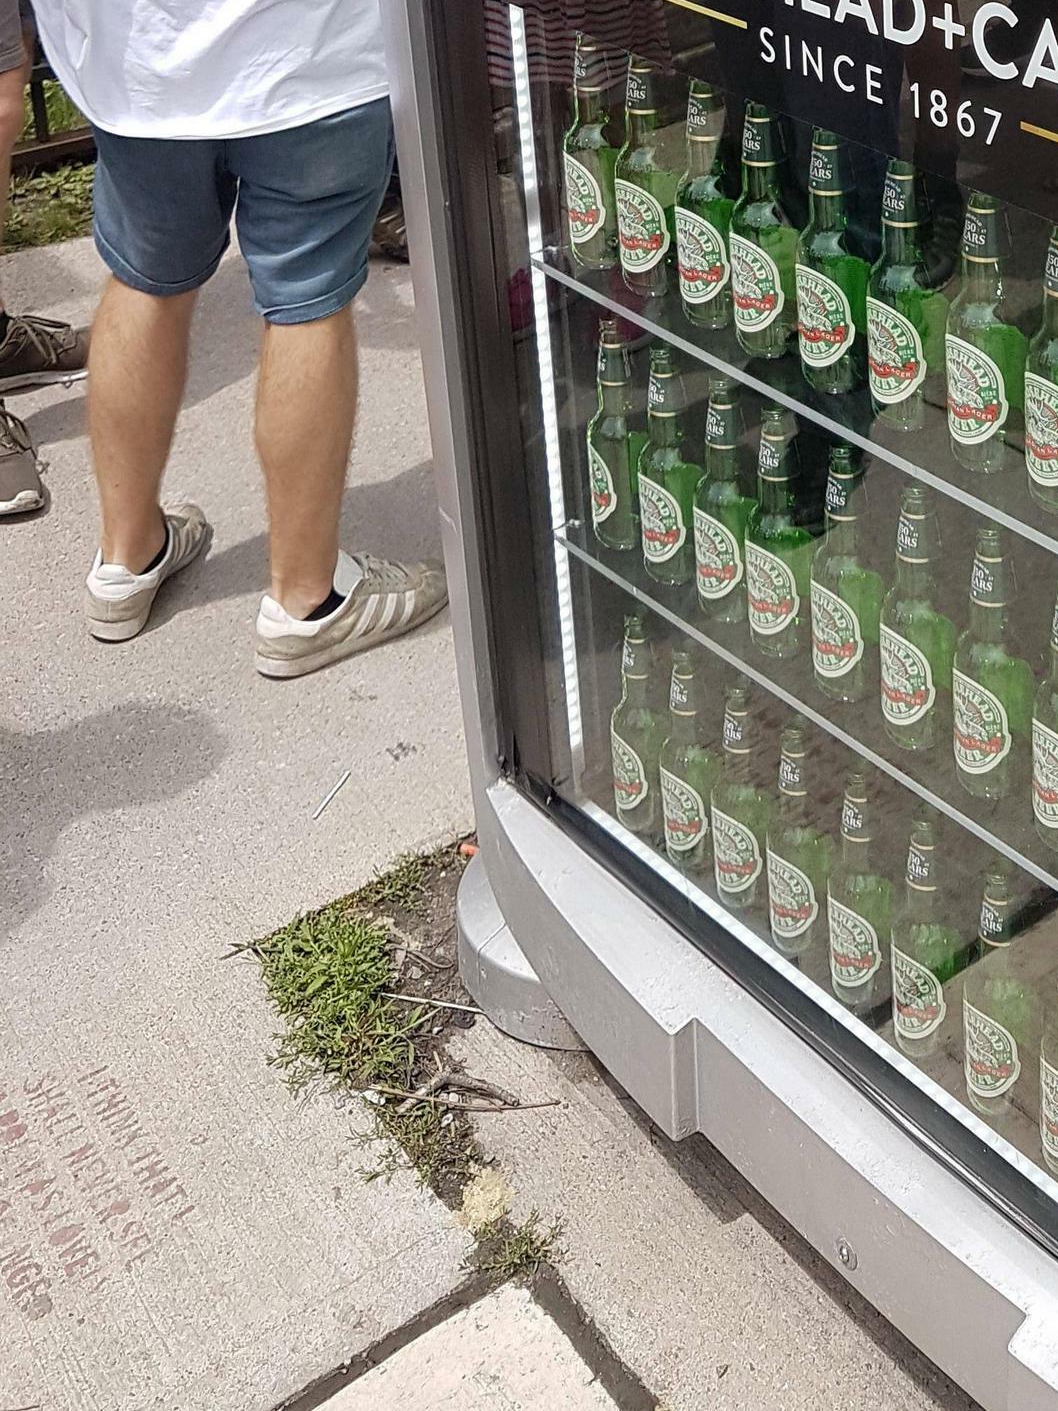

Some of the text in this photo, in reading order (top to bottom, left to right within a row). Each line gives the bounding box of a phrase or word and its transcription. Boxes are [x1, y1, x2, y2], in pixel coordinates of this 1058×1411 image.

[760, 26, 1002, 145] SINCE 1867
[963, 230, 986, 245] EARS
